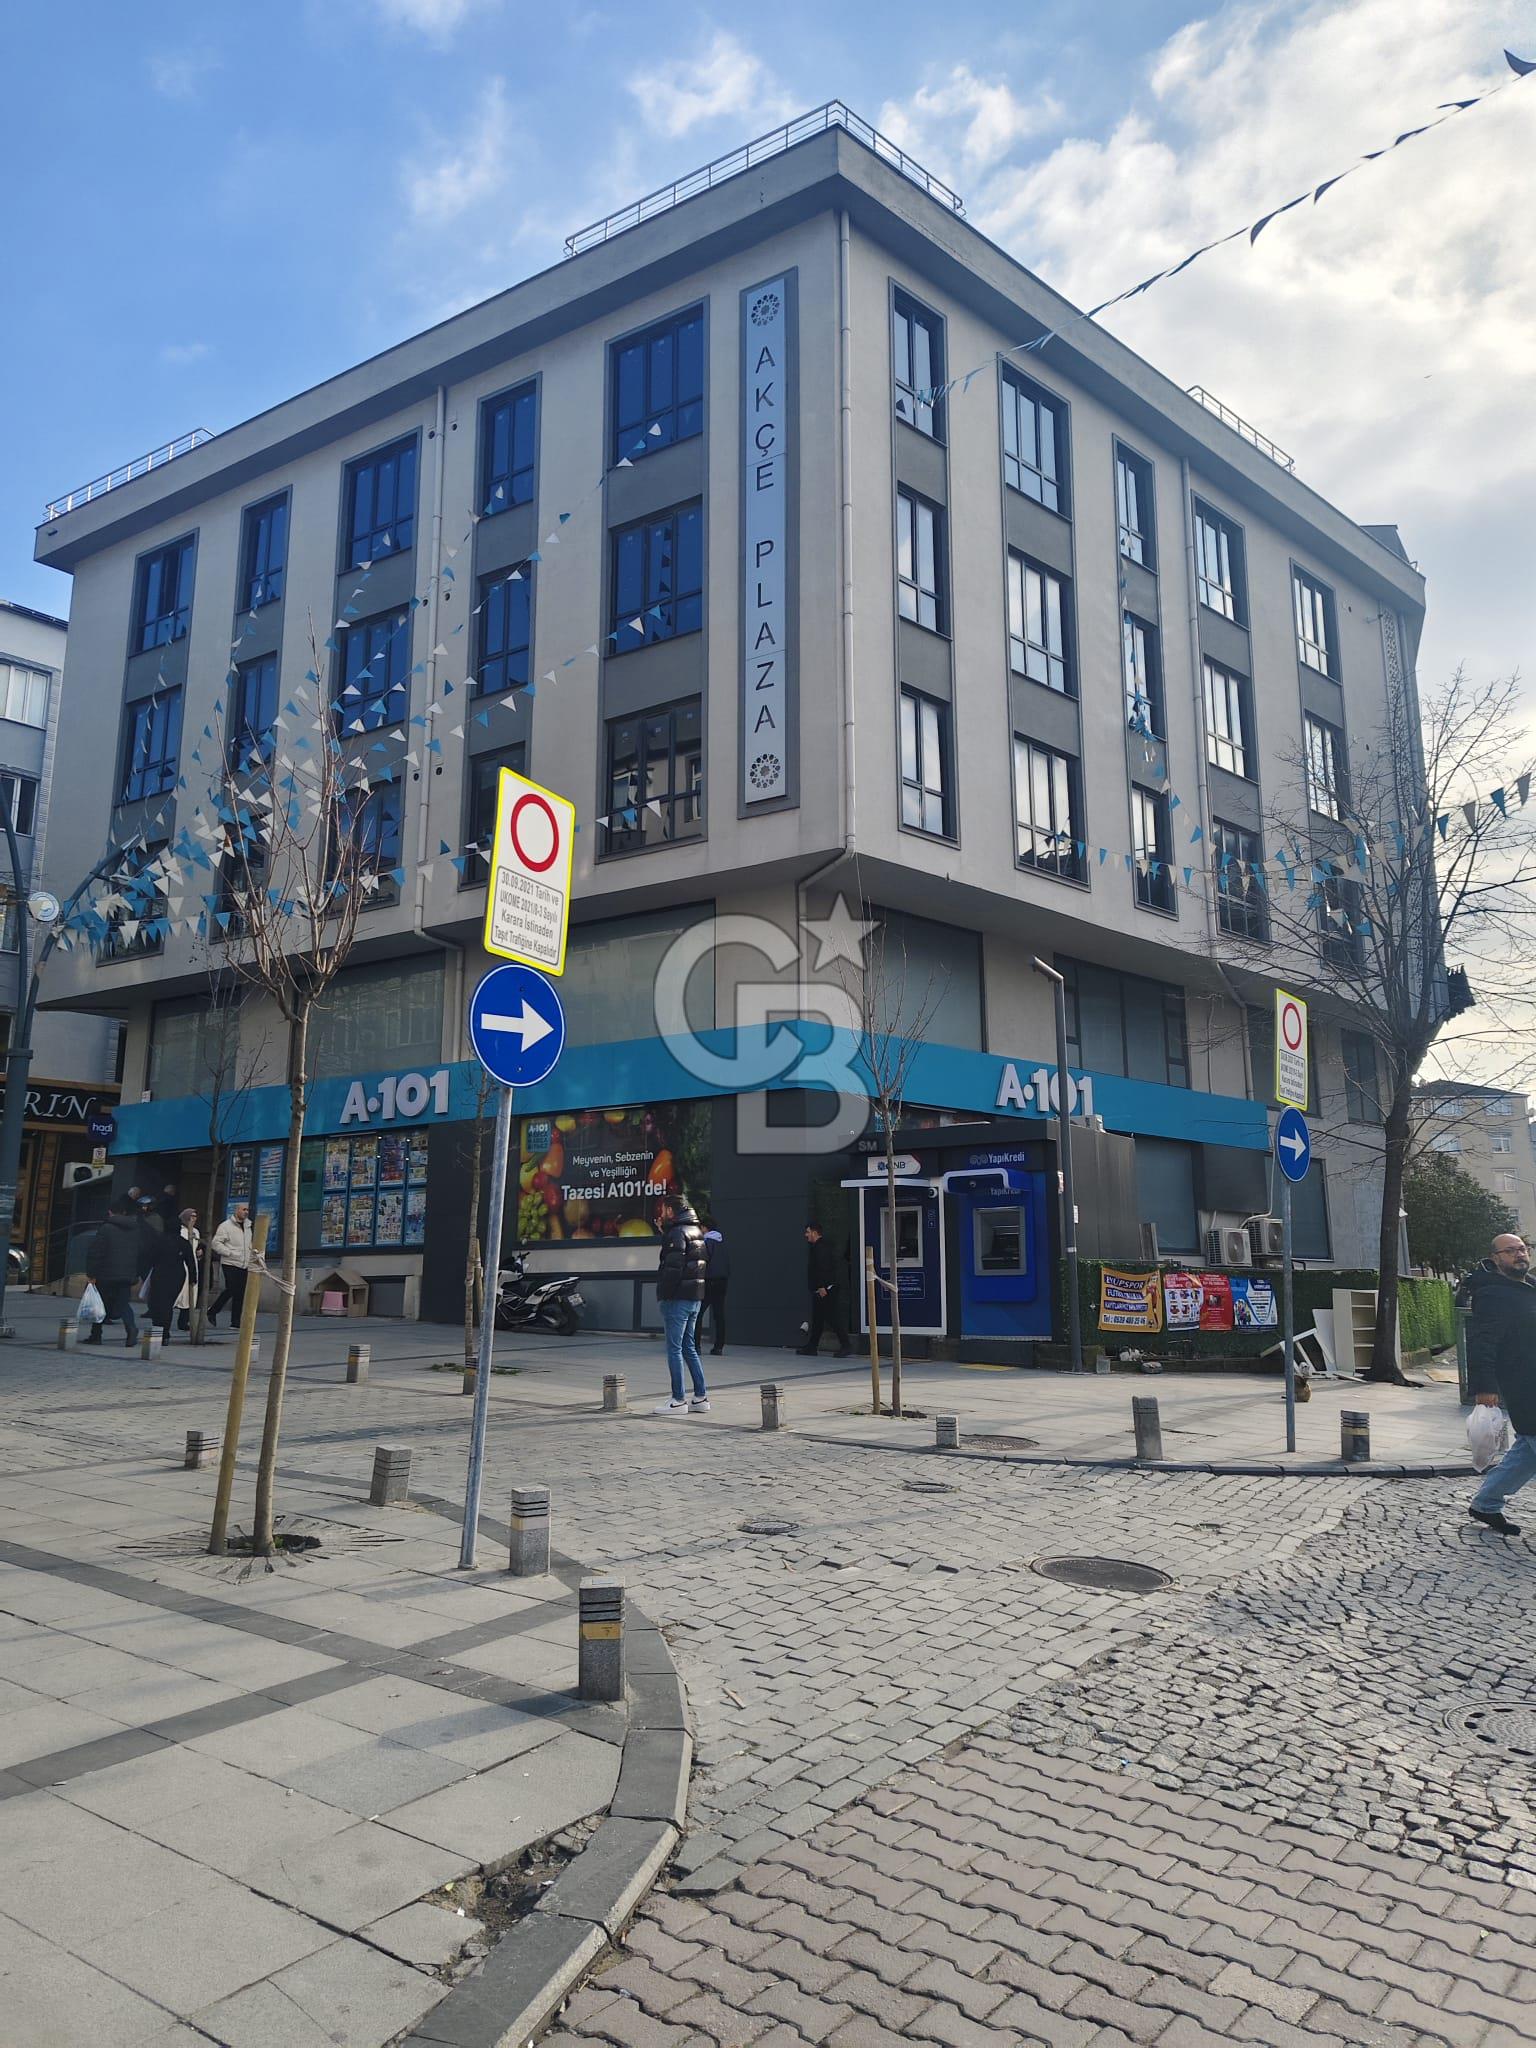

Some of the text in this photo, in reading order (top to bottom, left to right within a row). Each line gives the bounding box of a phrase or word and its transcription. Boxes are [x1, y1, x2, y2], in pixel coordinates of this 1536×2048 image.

[754, 345, 776, 733] AKÇE PLAZA
[501, 871, 559, 906] 30.09.2021 Tarih ve
[501, 908, 523, 928] Karara
[92, 1122, 113, 1132] hadi
[572, 1150, 654, 1167] Meyvenin, Sebzenin
[589, 1165, 637, 1179] ve Yeşilliğin
[561, 1183, 605, 1200] Tazesi
